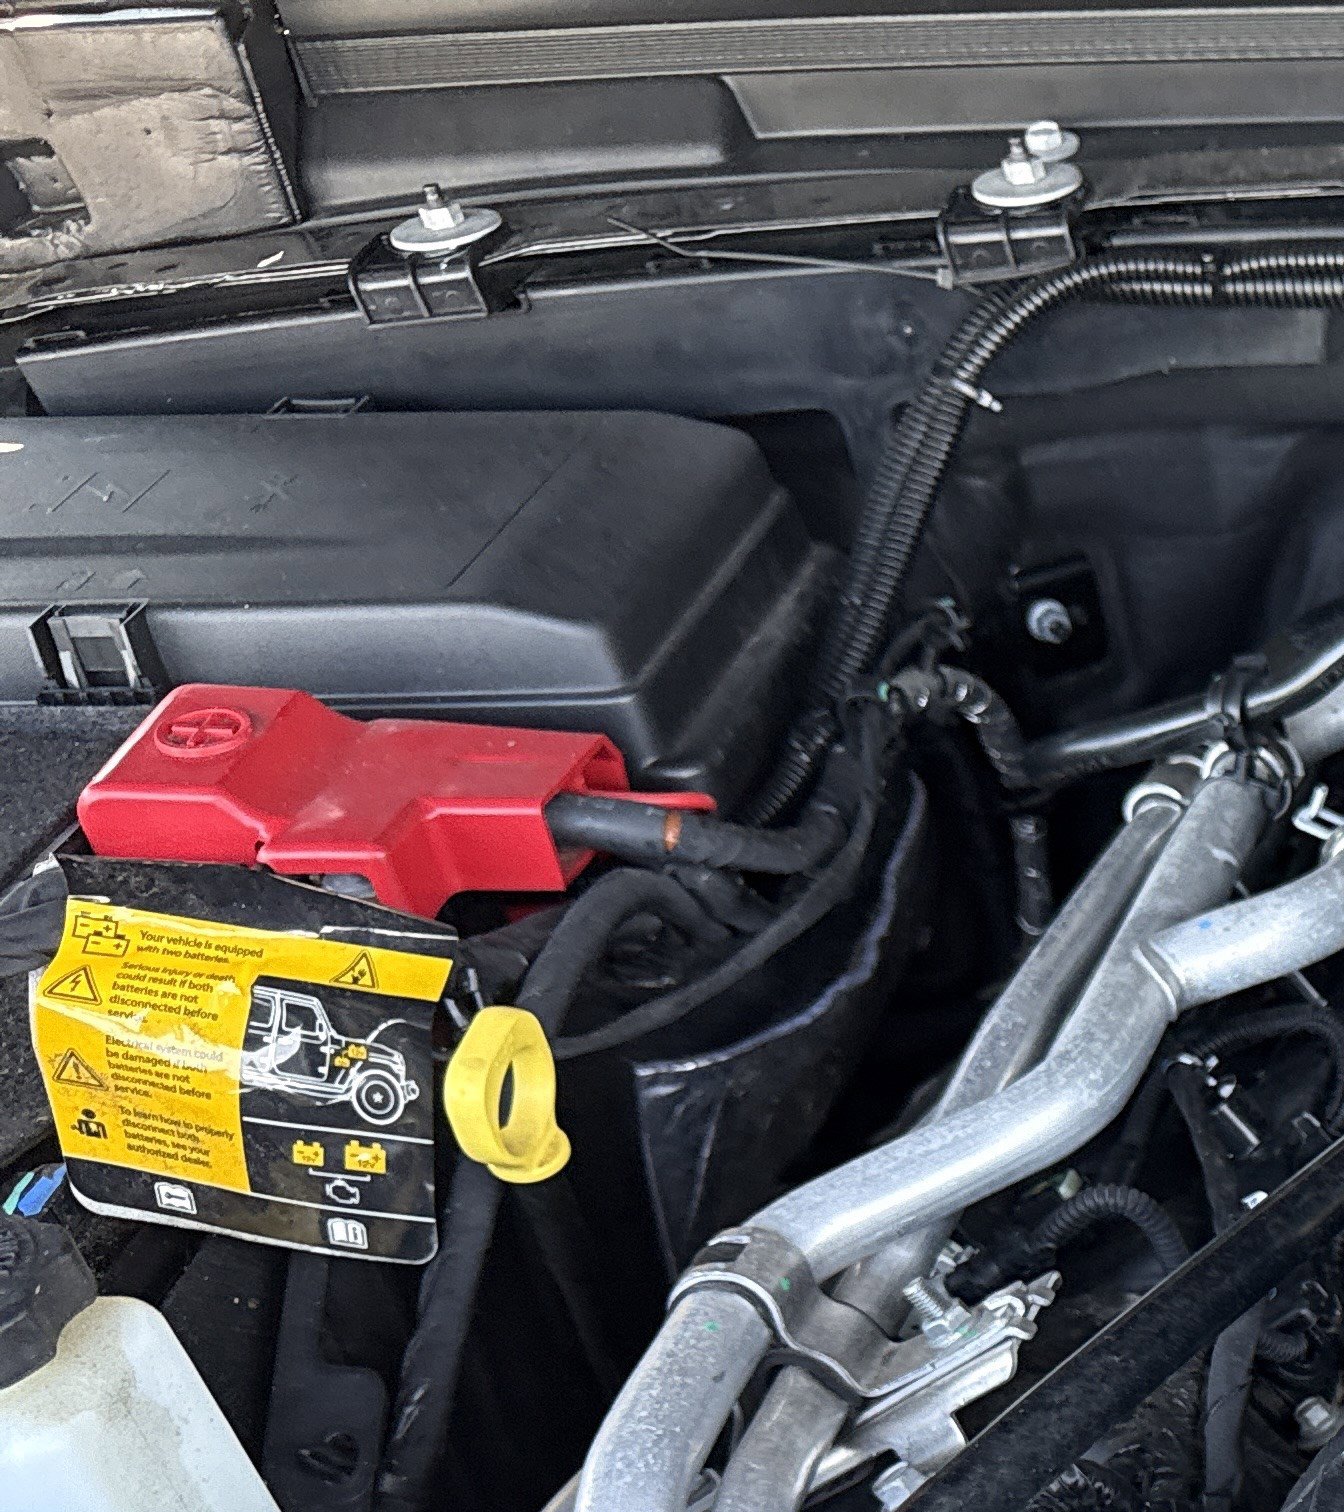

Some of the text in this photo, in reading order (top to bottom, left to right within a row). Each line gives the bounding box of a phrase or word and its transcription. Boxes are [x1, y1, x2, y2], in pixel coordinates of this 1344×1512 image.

[137, 945, 229, 963] with two batteries.
[141, 930, 264, 958] Your vehicle is equipped
[122, 962, 159, 973] Serious
[161, 966, 191, 978] injury
[112, 981, 199, 1004] batteries are not
[116, 972, 214, 993] could result if both
[109, 995, 218, 1021] disconnected before
[106, 1048, 120, 1058] be
[122, 1051, 171, 1068] damaged
[108, 1061, 190, 1084] batteries are not
[179, 1085, 211, 1100] before
[119, 1105, 131, 1115] To
[195, 1123, 235, 1141] properly
[122, 1118, 175, 1136] disconnect
[127, 1143, 178, 1161] authorized
[188, 1146, 210, 1157] your
